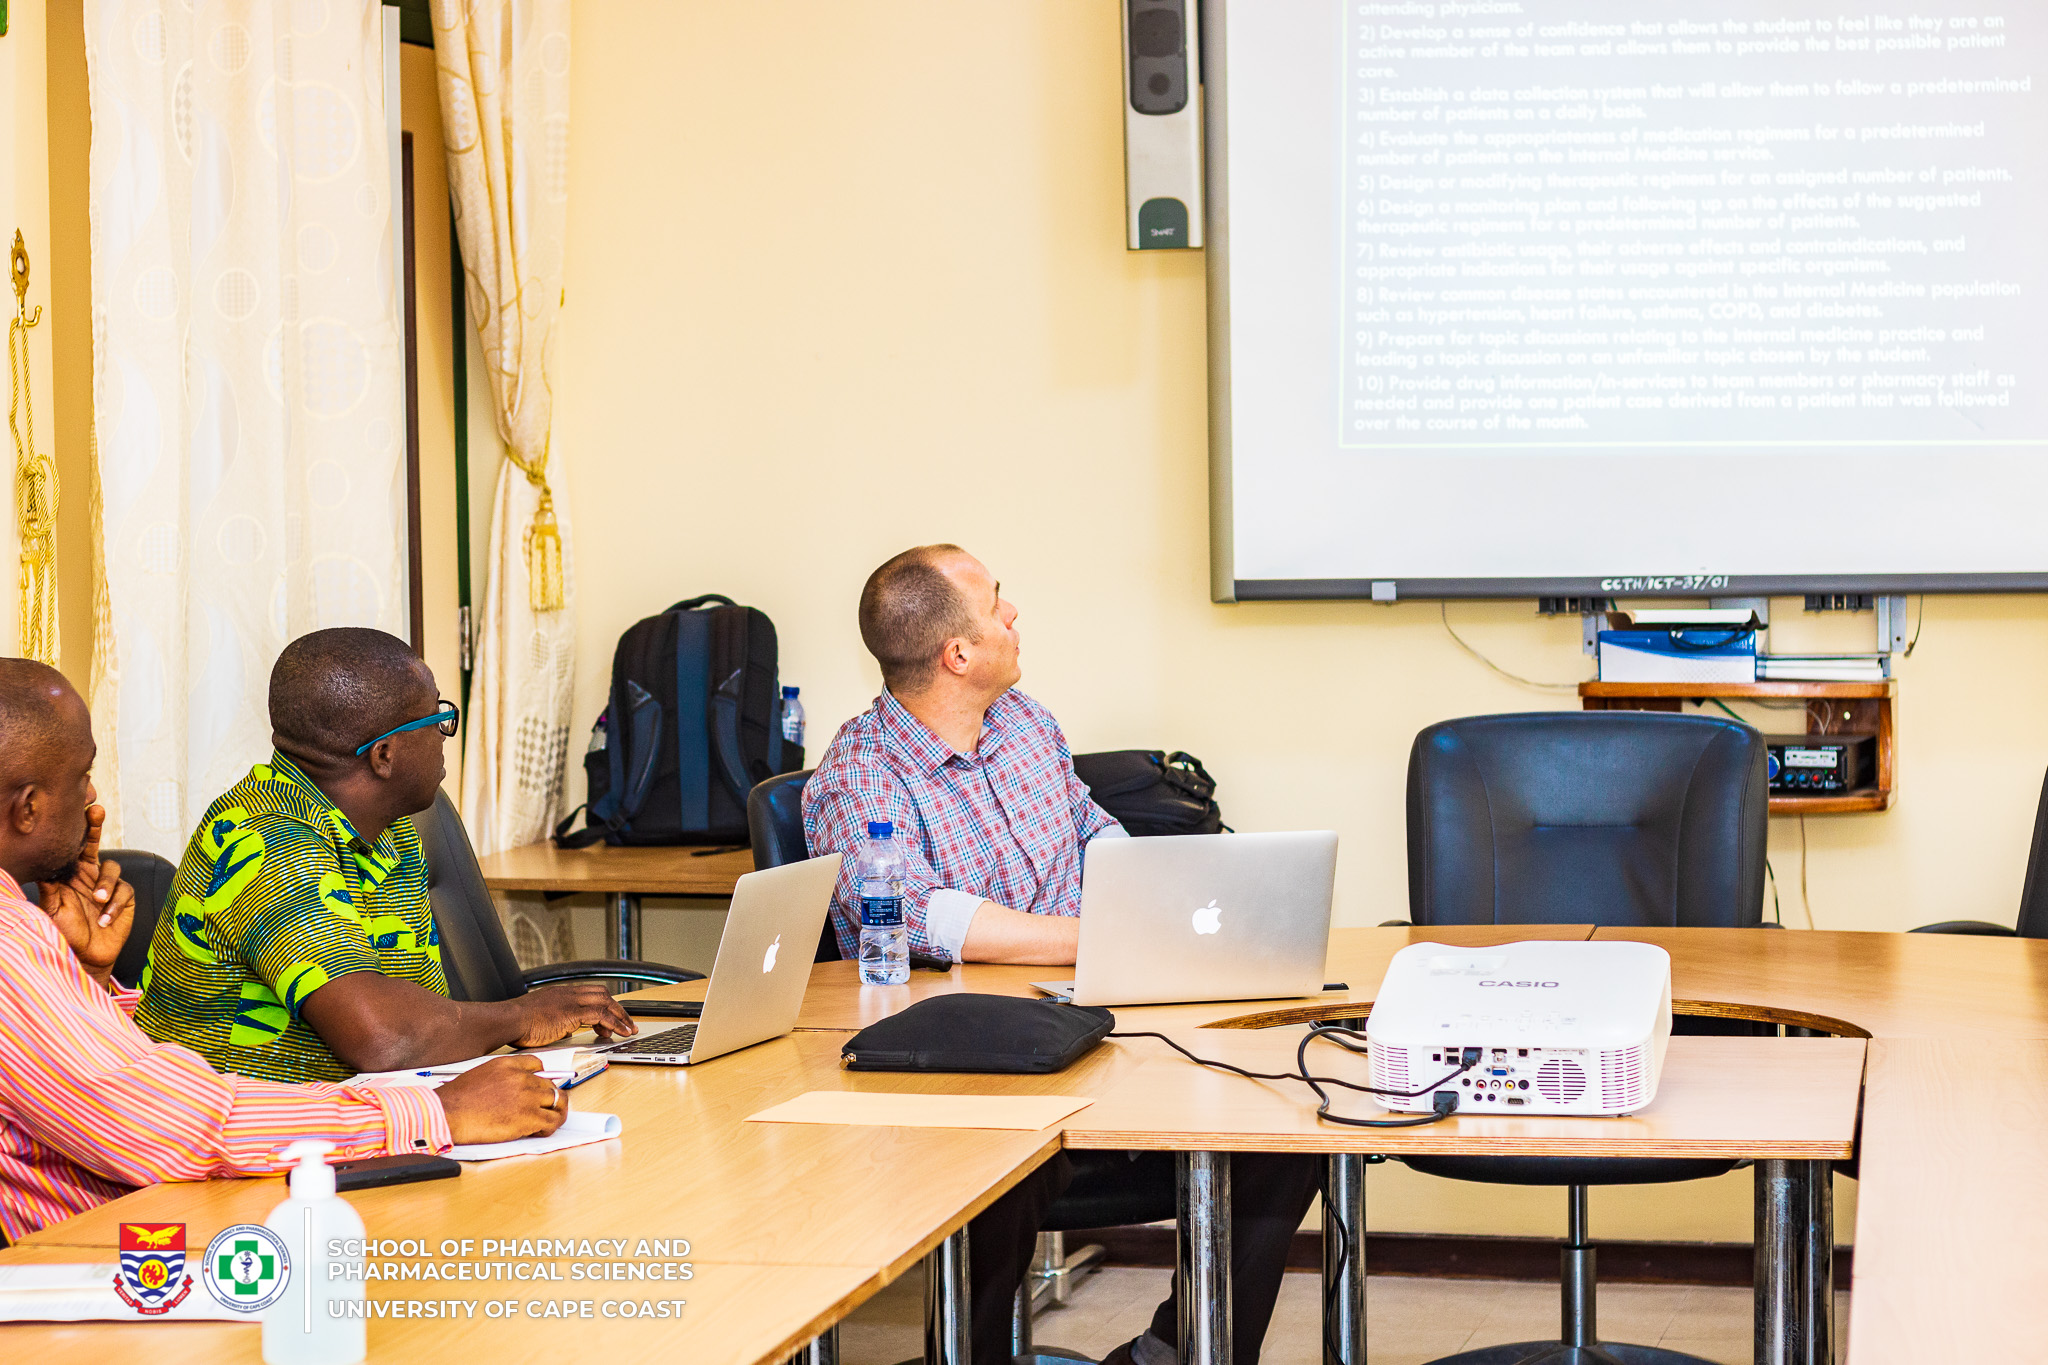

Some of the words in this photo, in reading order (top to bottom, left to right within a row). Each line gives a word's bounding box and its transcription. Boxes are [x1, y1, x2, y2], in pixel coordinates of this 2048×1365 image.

[1360, 25, 1375, 43] 2)
[1380, 23, 1447, 43] Develop
[1452, 27, 1464, 38] a
[1468, 26, 1511, 38] sense
[1516, 22, 1534, 37] of
[1538, 20, 1626, 37] confidence
[1630, 20, 1662, 35] that
[1666, 19, 1718, 34] allows
[1722, 18, 1748, 33] the
[1753, 17, 1811, 33] student
[1815, 16, 1832, 32] to
[1837, 16, 1870, 31] feel
[1874, 15, 1902, 31] like
[1908, 14, 1943, 34] they
[1948, 18, 1978, 29] are
[1983, 17, 2004, 29] an
[1358, 43, 1406, 59] active
[1410, 42, 1476, 58] member
[1480, 41, 1498, 57] of
[1504, 41, 1529, 56] the
[1534, 40, 1575, 56] team
[1579, 39, 1612, 55] and
[1616, 38, 1668, 54] allows
[1671, 37, 1711, 53] them
[1714, 37, 1732, 52] to
[1736, 36, 1800, 55] provide
[1804, 35, 1830, 51] the
[1834, 35, 1870, 50] best
[1874, 33, 1942, 53] possible
[1946, 32, 2006, 52] patient
[1357, 67, 1398, 78] care.
[1358, 88, 1375, 106] 3)
[1380, 86, 1448, 102] Establish
[1452, 90, 1464, 101] a
[1469, 85, 1509, 101] data
[1513, 84, 1588, 100] collection
[1592, 83, 1646, 103] system
[1650, 83, 1684, 98] that
[1688, 82, 1716, 97] will
[1720, 81, 1764, 97] allow
[1769, 81, 1809, 96] them
[1812, 80, 1830, 95] to
[1834, 79, 1885, 95] follow
[1889, 83, 1902, 94] a
[1906, 77, 2031, 97] predetermined
[1356, 105, 1416, 121] number
[1422, 105, 1440, 120] of
[1445, 104, 1510, 124] patients
[1514, 108, 1534, 119] on
[1538, 108, 1550, 119] a
[1554, 104, 1596, 123] daily
[1602, 103, 1647, 119] basis.
[1358, 131, 1374, 150] 4)
[1379, 130, 1448, 146] Evaluate
[1453, 129, 1478, 145] the
[1484, 127, 1616, 148] appropriateness
[1620, 127, 1638, 142] of
[1642, 126, 1732, 142] medication
[1736, 124, 1810, 144] regimens
[1814, 124, 1839, 139] for
[1843, 128, 1856, 139] a
[1860, 122, 1984, 142] predetermined
[1357, 176, 1374, 194] 5)
[1379, 175, 1434, 194] Design
[1460, 173, 1542, 193] modifying
[1546, 172, 1638, 191] therapeutic
[1642, 170, 1716, 190] regimens
[1720, 170, 1744, 185] for
[1749, 173, 1770, 185] an
[1775, 168, 1848, 188] assigned
[1852, 167, 1914, 183] number
[1918, 167, 1936, 182] of
[1942, 166, 2012, 185] patients.
[1356, 307, 1390, 322] such
[1395, 311, 1414, 322] as
[1418, 306, 1526, 325] hypertension,
[1530, 305, 1574, 321] heart
[1578, 305, 1636, 322] failure,
[1641, 304, 1704, 321] asthma,
[1708, 304, 1764, 321] COPD,
[1769, 303, 1800, 319] and
[1806, 303, 1883, 318] diabetes.
[1355, 351, 1417, 370] leading
[1422, 355, 1434, 366] a
[1439, 350, 1480, 369] topic
[1484, 350, 1562, 365] discussion
[1566, 353, 1587, 365] on
[1591, 353, 1612, 364] an
[1616, 349, 1699, 364] unfamiliar
[1704, 348, 1744, 367] topic
[1749, 348, 1804, 363] chosen
[1810, 348, 1831, 366] by
[1836, 347, 1862, 363] the
[1867, 347, 1930, 362] student.
[1358, 376, 1384, 394] 10)
[1389, 375, 1451, 391] Provide
[1456, 375, 1494, 394] drug
[1690, 373, 1708, 388] to
[1712, 373, 1754, 388] team
[1758, 372, 1834, 388] members
[1862, 371, 1946, 390] pharmacy
[1951, 371, 1990, 386] staff
[1996, 374, 2016, 386] as
[1354, 395, 1417, 410] needed
[1422, 395, 1454, 410] and
[1460, 394, 1522, 413] provide
[1528, 398, 1558, 409] one
[1563, 394, 1621, 412] patient
[1625, 397, 1662, 409] case
[1668, 393, 1732, 408] derived
[1736, 393, 1776, 408] from
[1780, 396, 1792, 408] a
[1797, 392, 1856, 411] patient
[1860, 392, 1894, 407] that
[1898, 396, 1932, 407] was
[1937, 391, 2009, 406] followed
[1354, 419, 1390, 430] over
[1396, 415, 1421, 430] the
[1426, 419, 1478, 430] course
[1482, 414, 1500, 430] of
[1506, 414, 1532, 429] the
[1536, 414, 1589, 429] month.
[1478, 980, 1559, 988] CASIO
